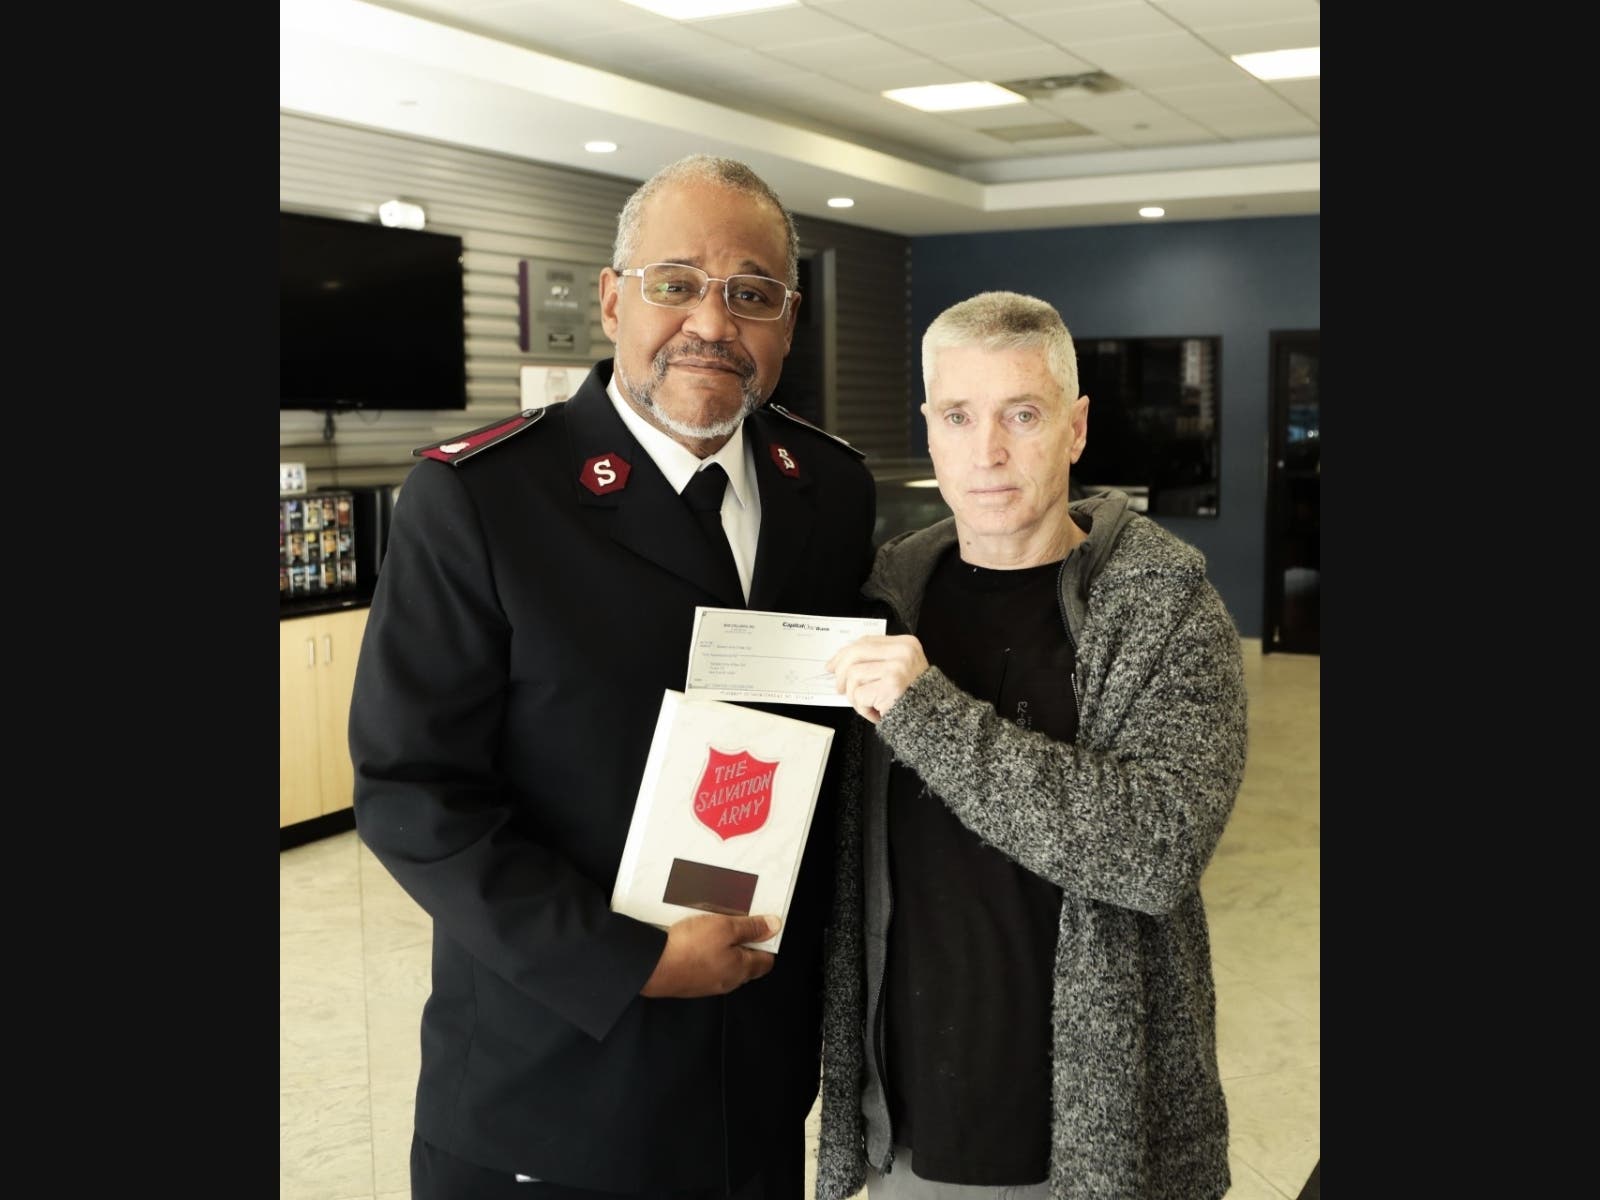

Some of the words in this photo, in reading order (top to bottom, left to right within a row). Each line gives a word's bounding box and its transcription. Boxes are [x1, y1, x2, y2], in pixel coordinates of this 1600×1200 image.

[593, 459, 617, 487] S
[714, 759, 748, 784] THE
[695, 770, 771, 813] SALVATION
[717, 796, 765, 828] ARMY
